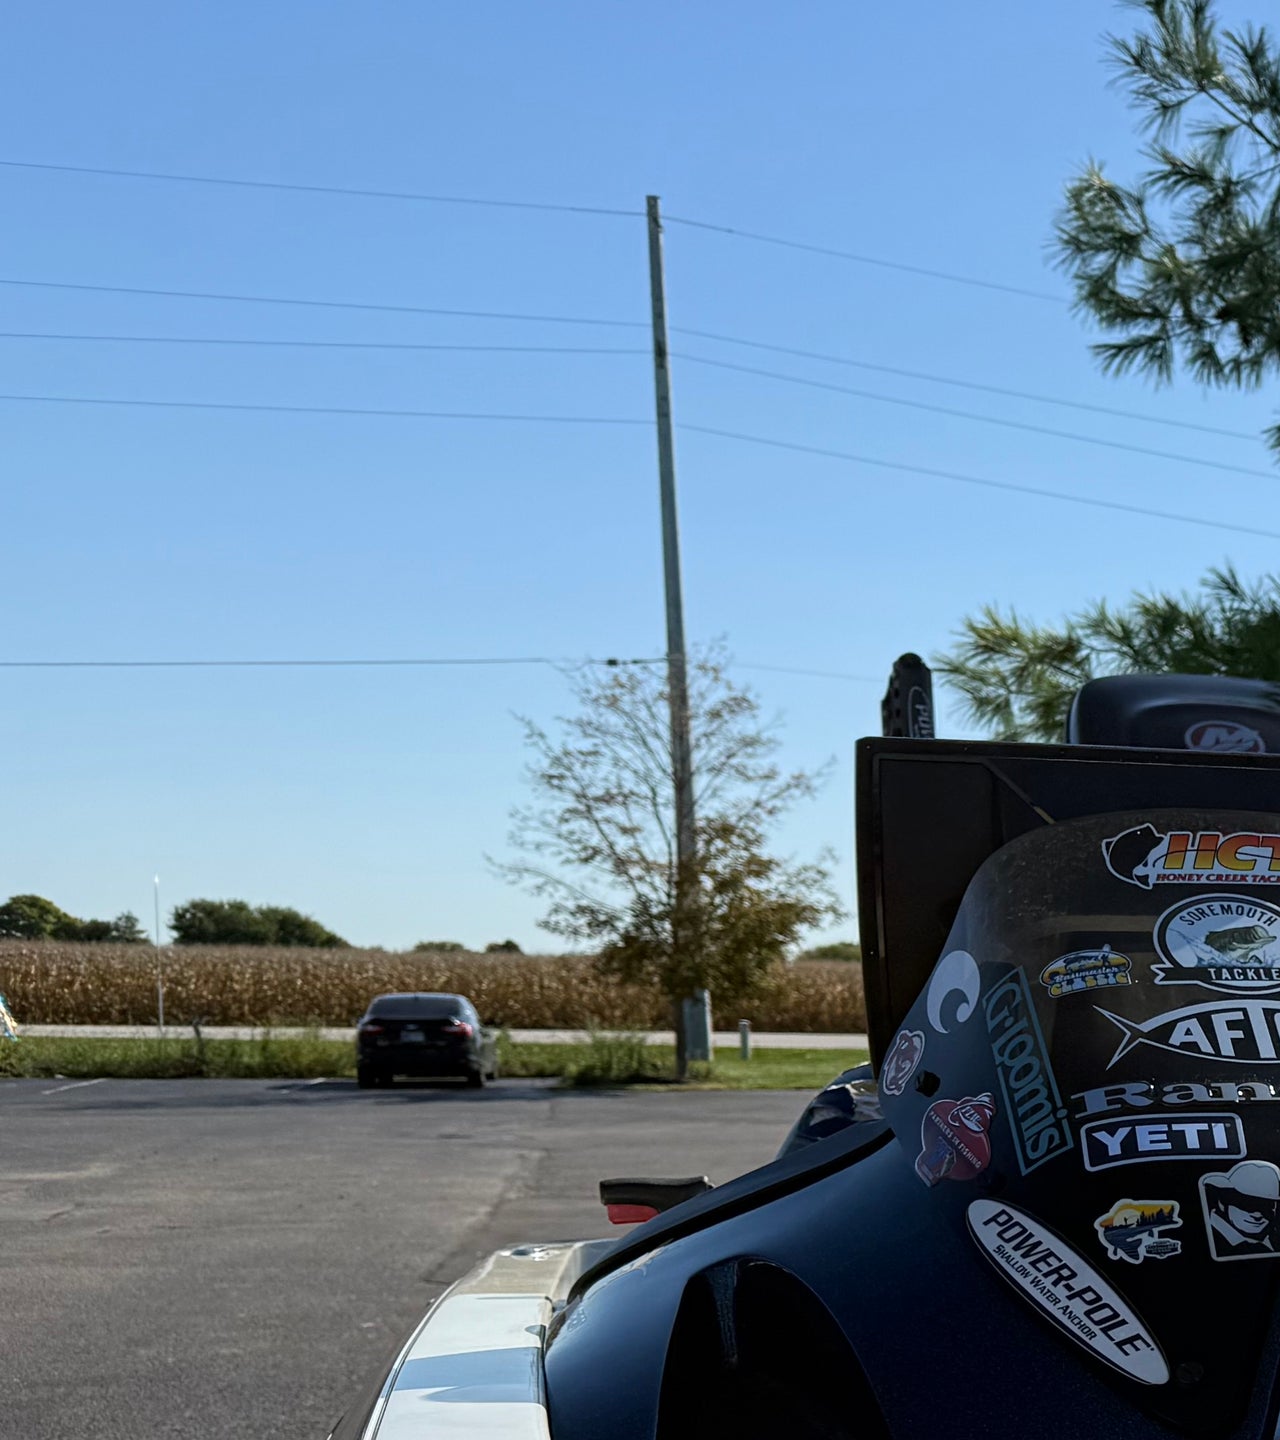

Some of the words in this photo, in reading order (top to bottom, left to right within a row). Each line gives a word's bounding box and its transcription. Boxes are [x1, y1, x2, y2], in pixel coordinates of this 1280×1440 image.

[1156, 873, 1203, 883] HONEY
[1205, 873, 1248, 883] CREEK
[1179, 903, 1278, 927] SOREMOUTH
[959, 1142, 982, 1169] FISHING
[1090, 1122, 1232, 1158] YETI
[982, 1208, 1152, 1358] POWER-POLE
[993, 1243, 1033, 1279] SHALLOW
[1029, 1275, 1061, 1307] WATER
[1057, 1303, 1098, 1341] ANCHOR
